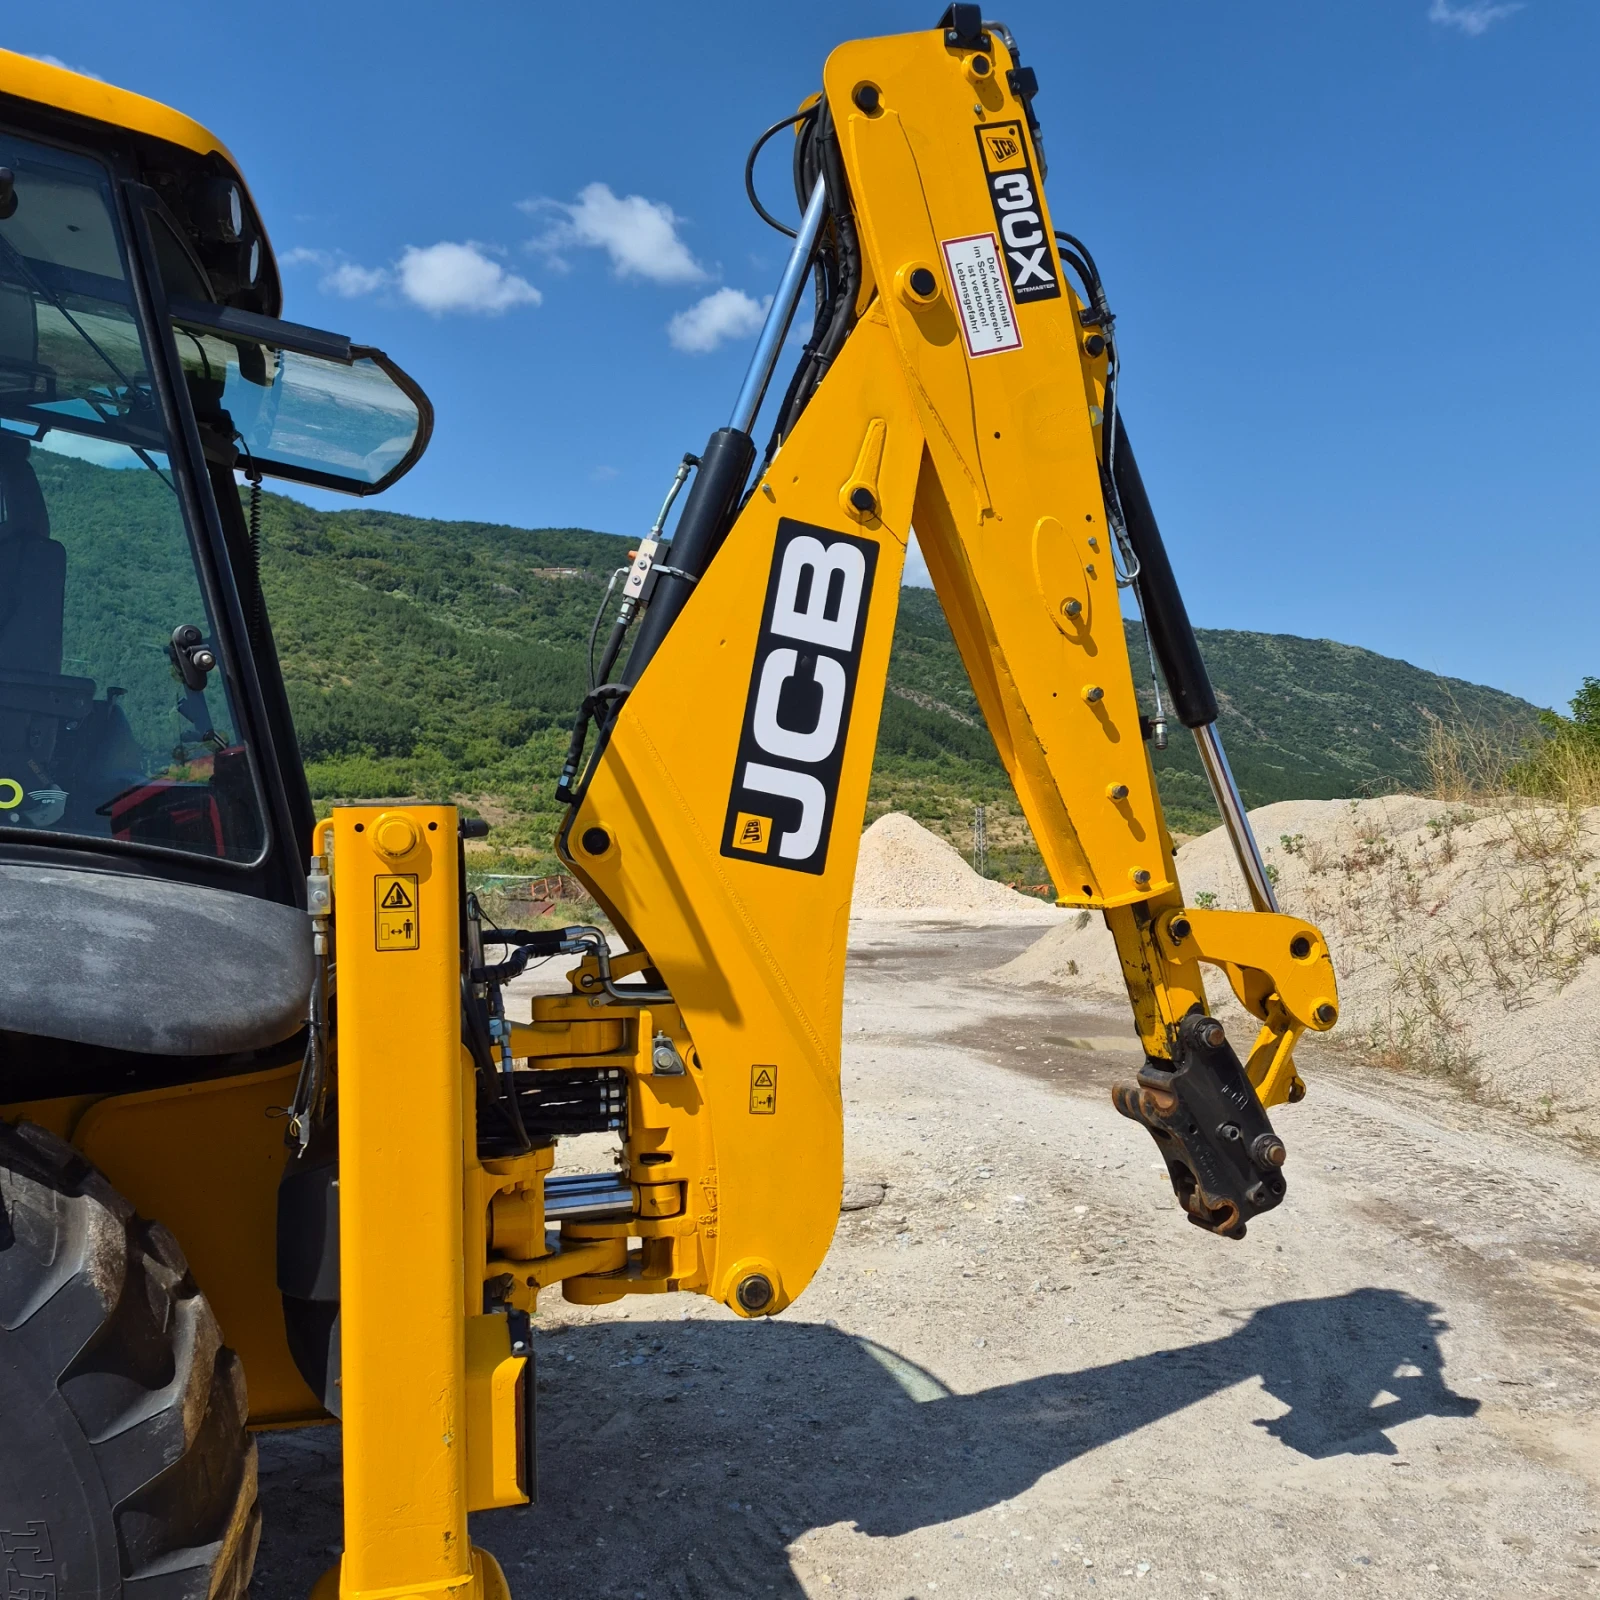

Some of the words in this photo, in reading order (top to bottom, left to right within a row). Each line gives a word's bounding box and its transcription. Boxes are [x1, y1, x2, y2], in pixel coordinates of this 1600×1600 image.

[992, 140, 1017, 159] JCB
[973, 246, 982, 258] im
[994, 173, 1055, 286] 3CX
[967, 265, 976, 277] ist
[987, 257, 996, 274] Der
[992, 277, 1010, 328] Aufenthalt
[1016, 283, 1055, 294] SITEMASTER
[955, 262, 980, 334] Lebensgefahr!
[971, 280, 989, 327] verboten!
[977, 261, 1003, 343] Schwenkbereich
[742, 535, 866, 860] JCB
[743, 821, 760, 841] JCB
